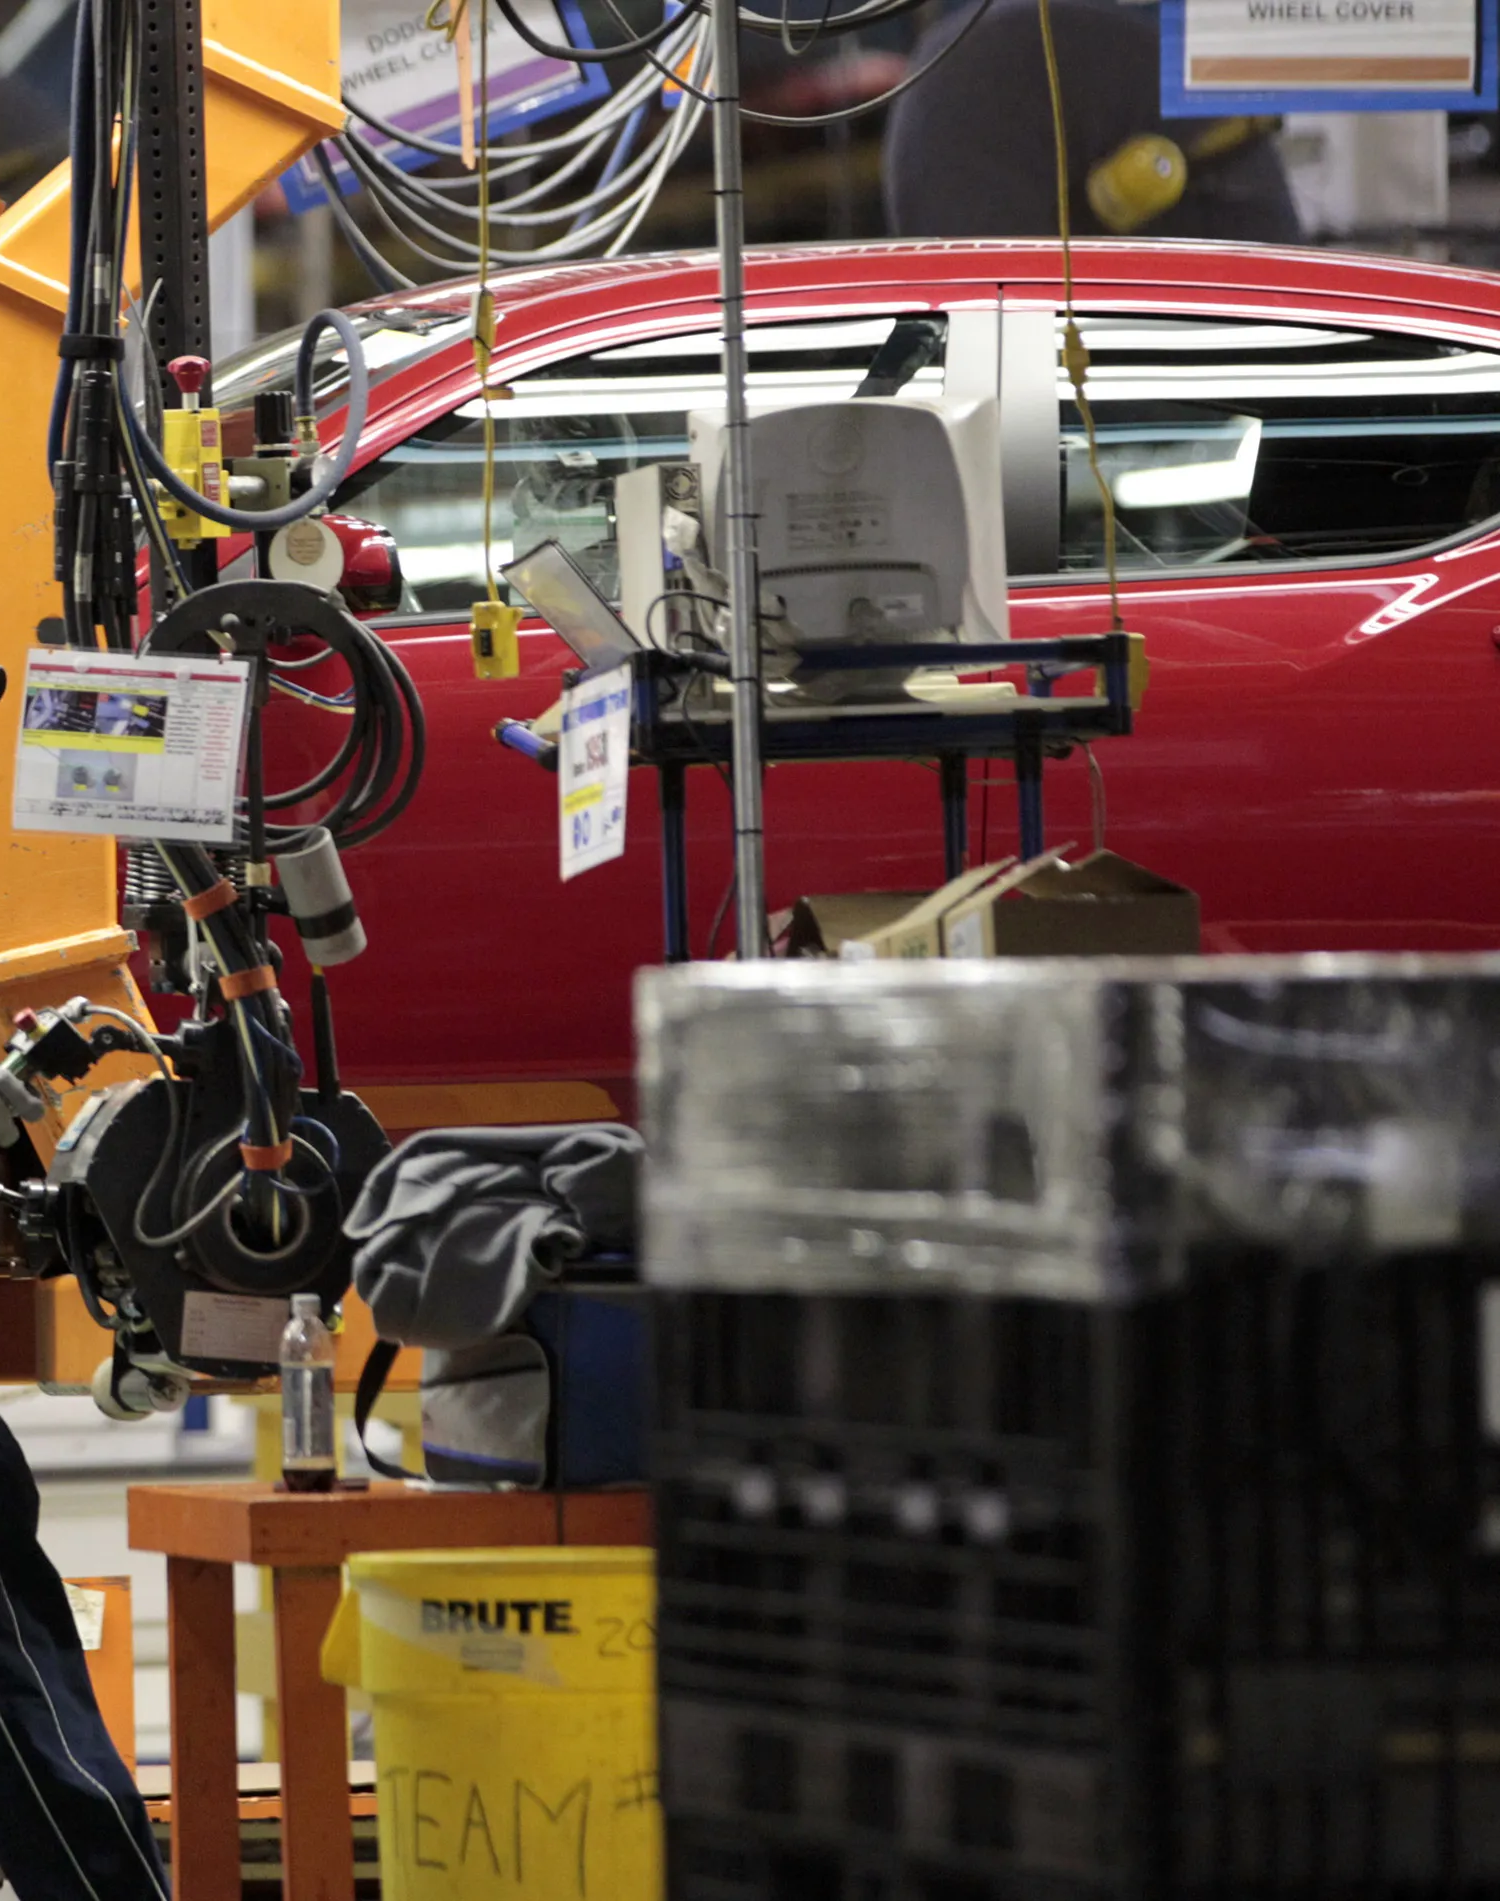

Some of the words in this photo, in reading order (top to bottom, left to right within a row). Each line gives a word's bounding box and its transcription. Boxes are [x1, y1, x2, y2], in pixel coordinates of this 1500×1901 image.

[1249, 0, 1324, 20] WHEEL
[1335, 0, 1415, 20] COVER
[340, 54, 415, 93] WHEEL
[420, 18, 496, 60] COER
[421, 1598, 573, 1636] BRUTE
[384, 1766, 592, 1898] TEAM
